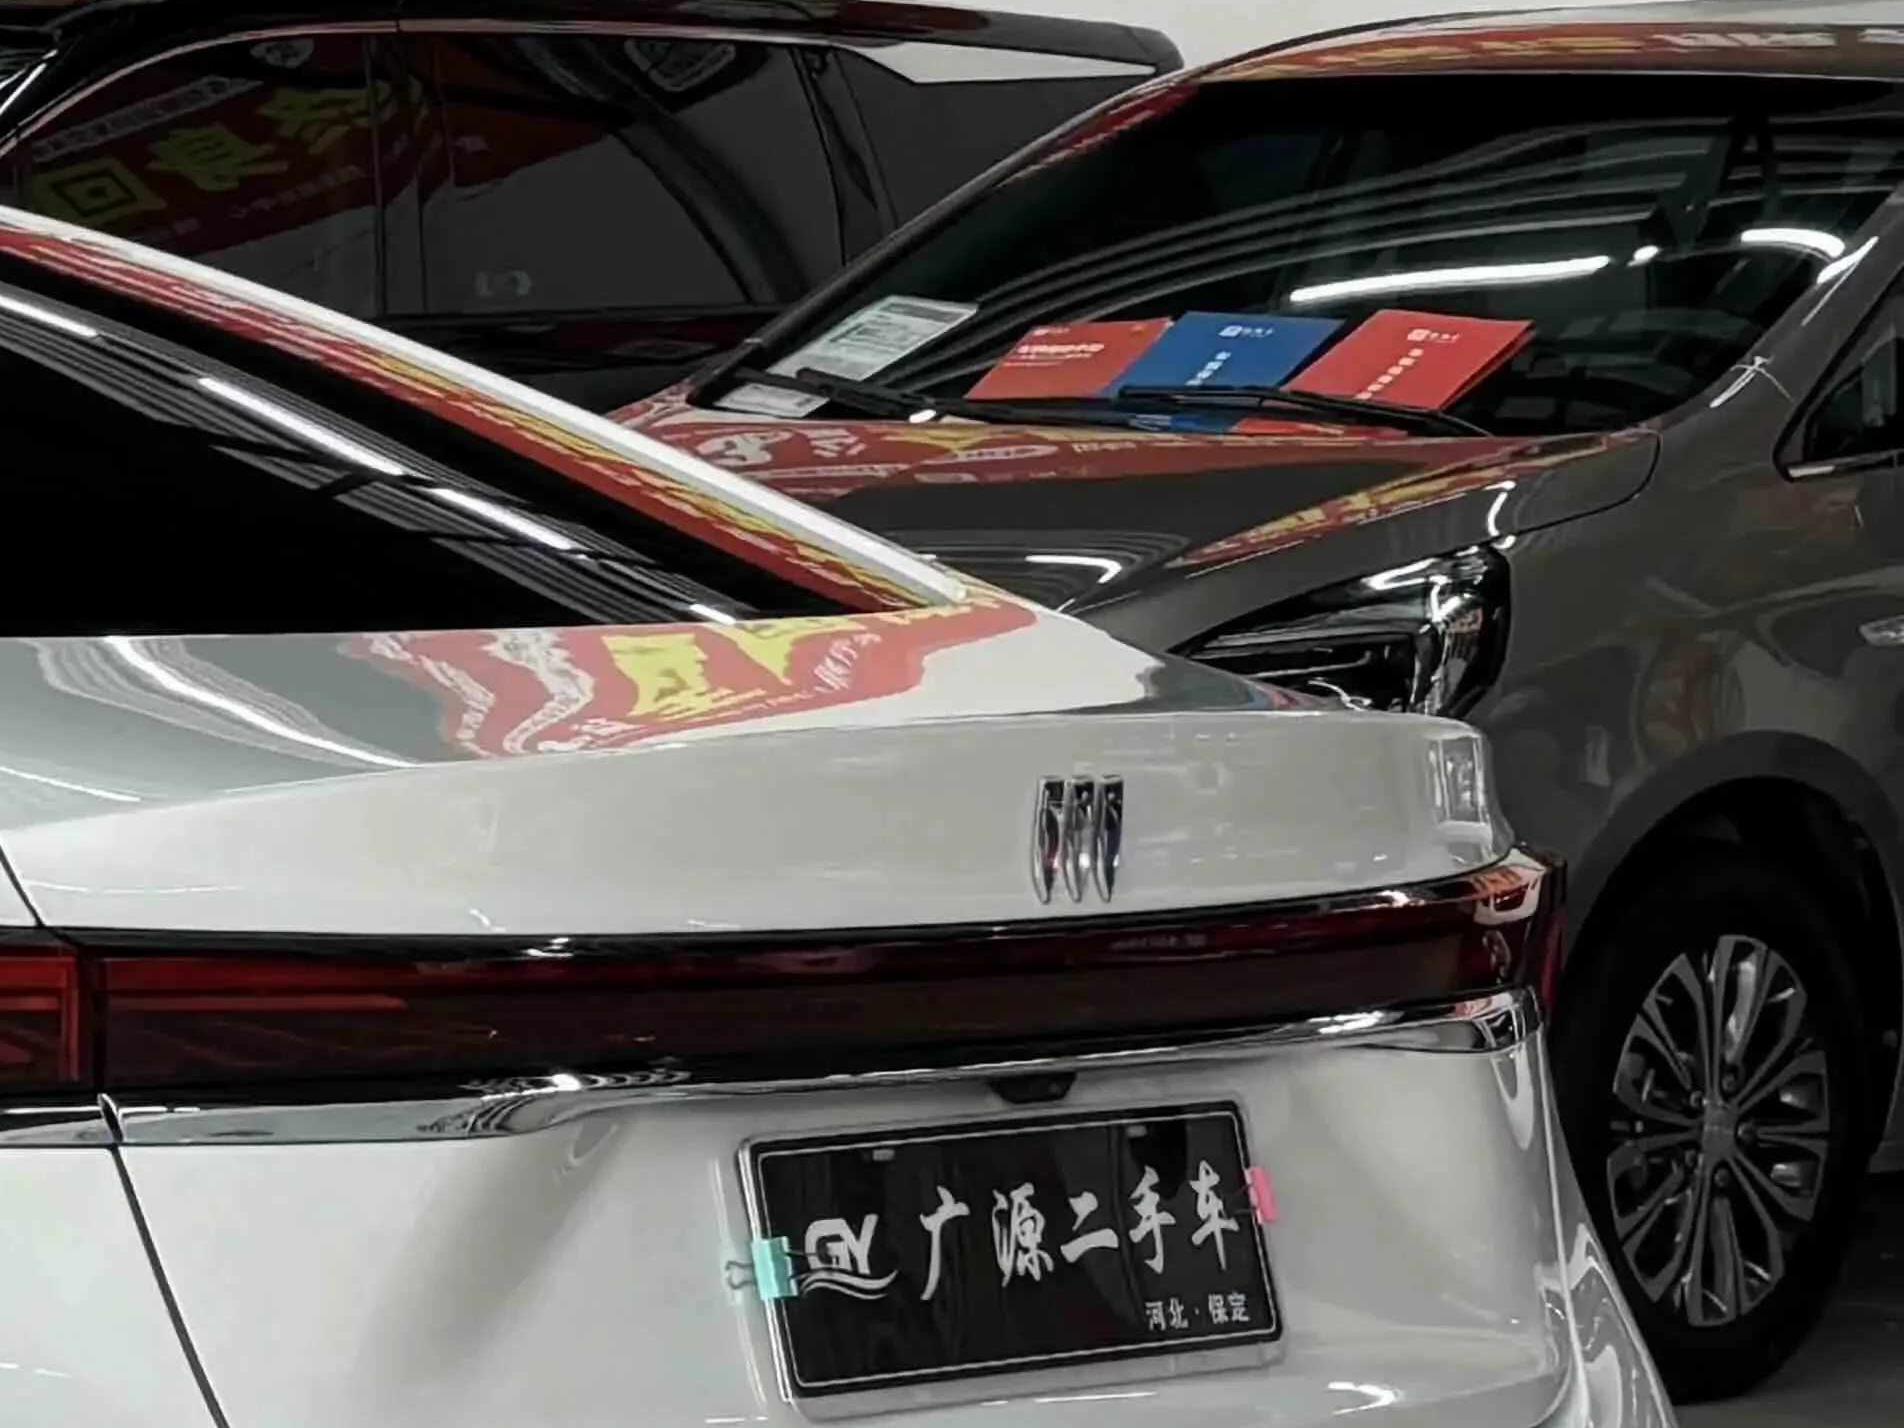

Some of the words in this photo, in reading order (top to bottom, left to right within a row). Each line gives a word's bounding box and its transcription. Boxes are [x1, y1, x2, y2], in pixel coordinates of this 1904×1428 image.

[920, 1160, 1240, 1301] 广源二手车
